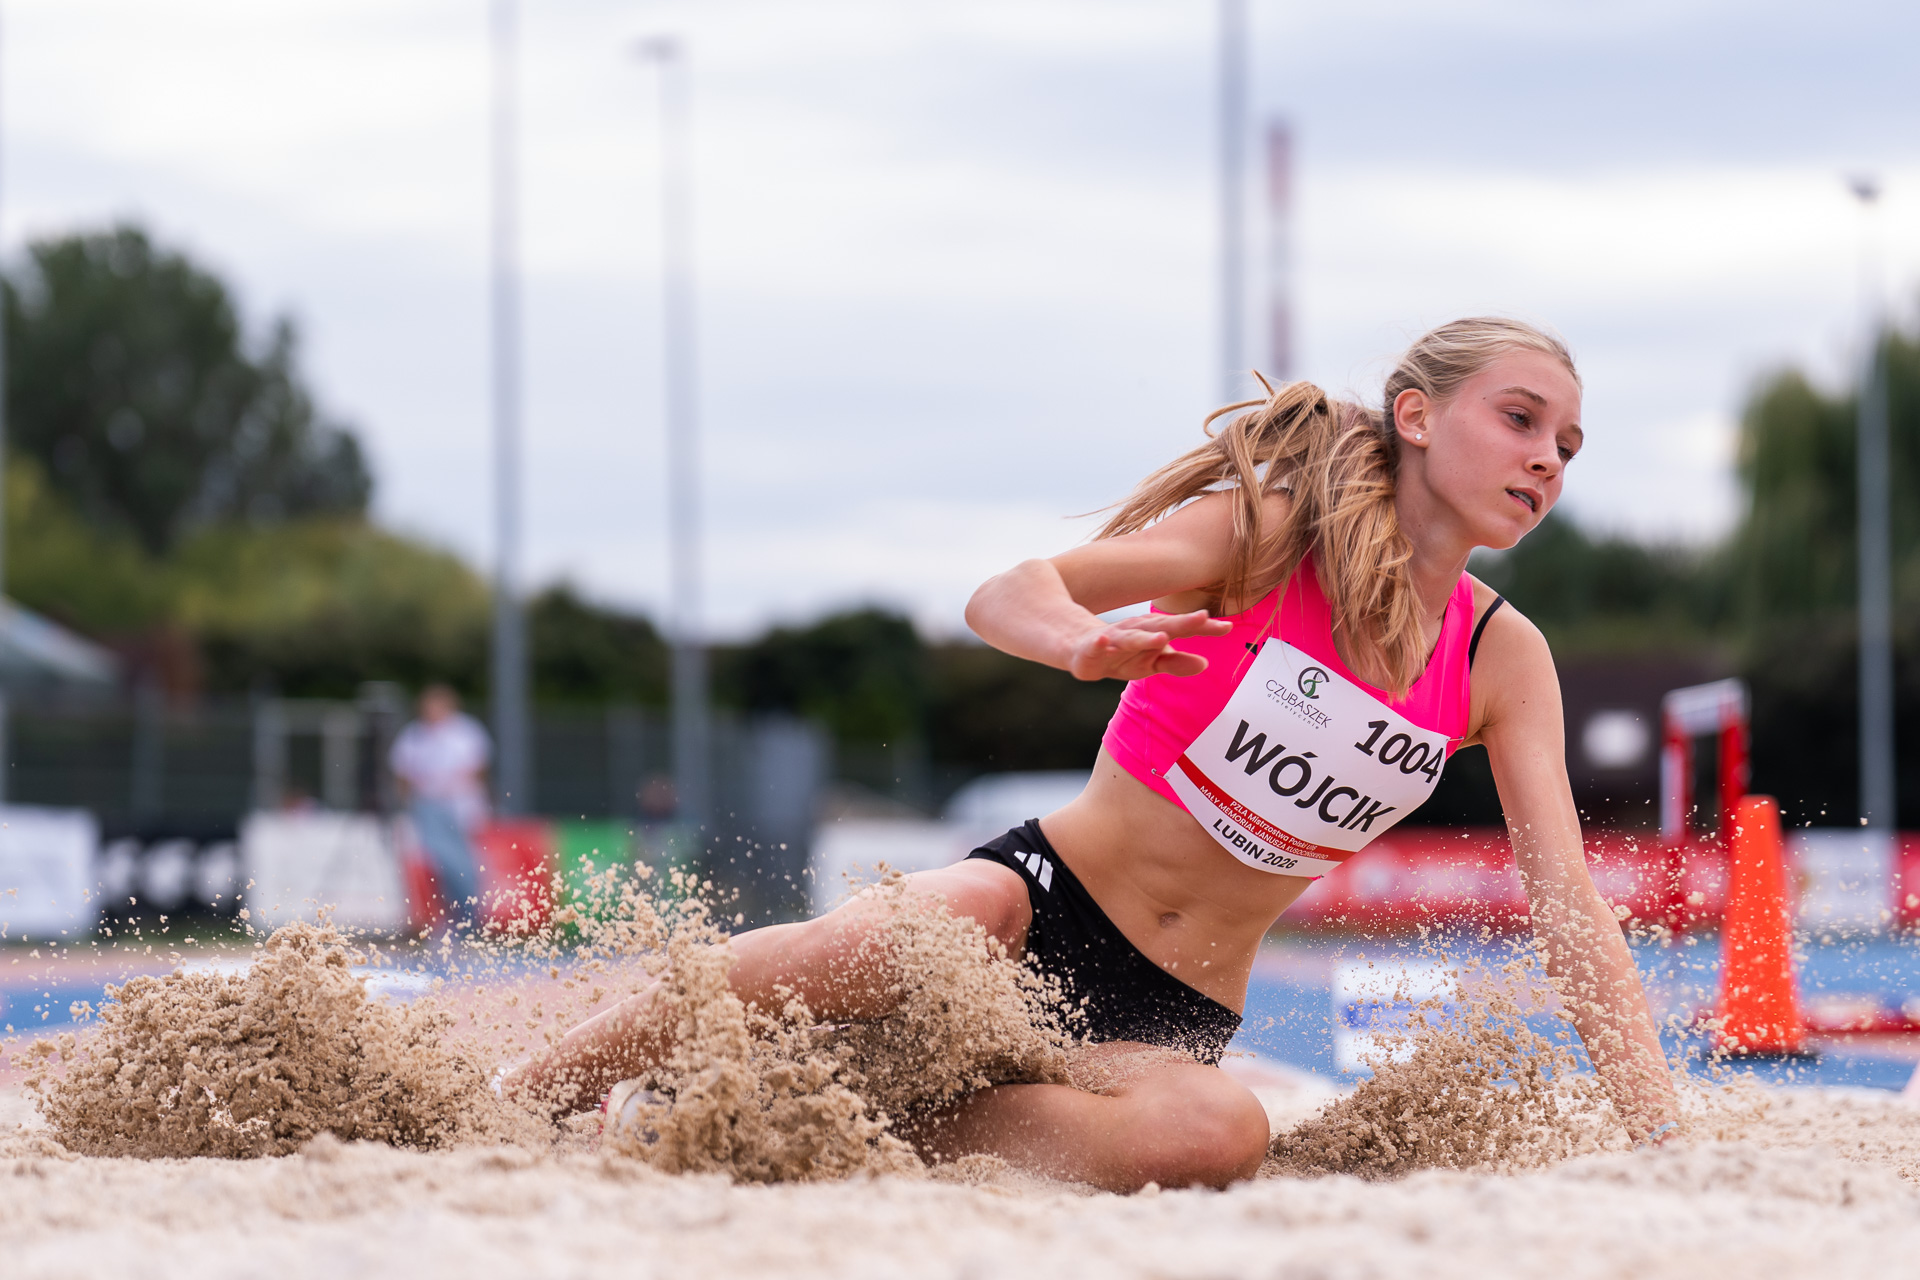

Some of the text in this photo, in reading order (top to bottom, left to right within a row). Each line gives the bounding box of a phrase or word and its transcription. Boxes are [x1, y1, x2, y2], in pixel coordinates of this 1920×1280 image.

[1266, 680, 1332, 728] CZUBASZEK
[1267, 693, 1320, 730] dietetycznie
[1224, 719, 1397, 832] WÓJCIK
[1354, 720, 1444, 783] 1004
[1200, 785, 1220, 804] MAŁY
[1218, 802, 1256, 832] MEMORIAŁ
[1255, 829, 1287, 849] JANUSZA
[1230, 801, 1248, 817] PZLA
[1247, 814, 1289, 840] Mistrzostwa
[1289, 837, 1308, 849] Polski
[1213, 818, 1298, 869] LUBIN 2026
